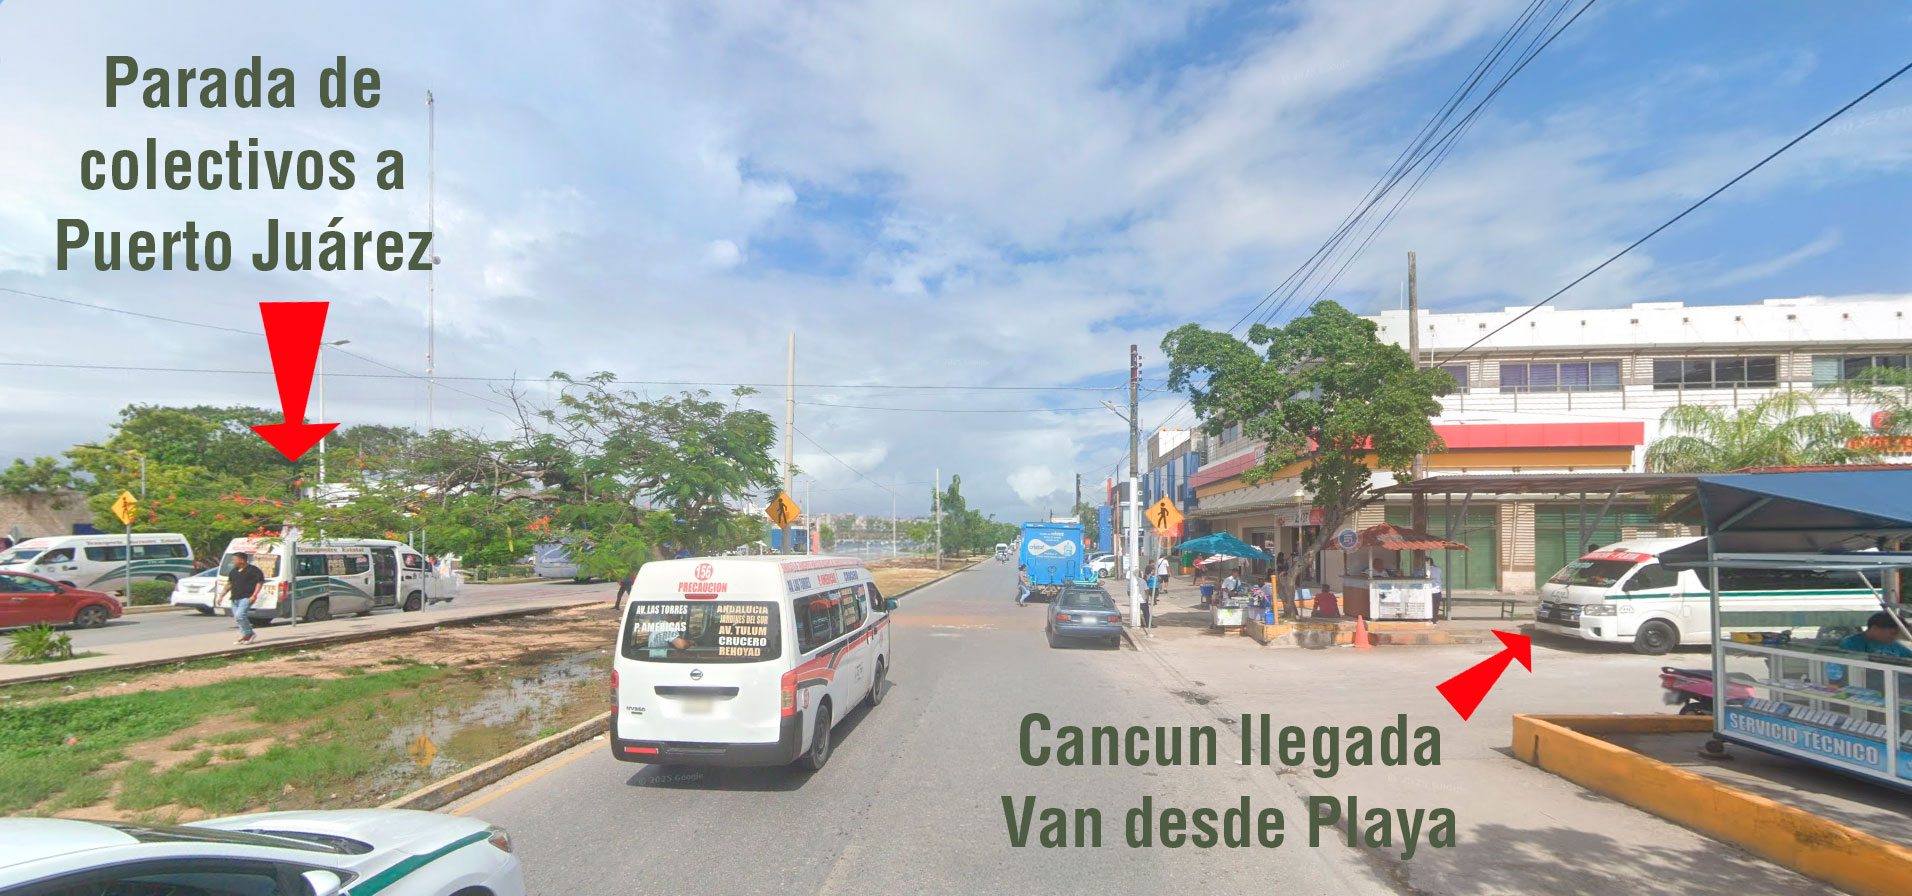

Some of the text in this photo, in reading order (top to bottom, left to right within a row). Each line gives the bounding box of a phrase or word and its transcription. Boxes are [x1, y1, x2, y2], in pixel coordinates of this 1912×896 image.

[695, 565, 712, 579] 156
[678, 582, 728, 593] PRECAUCION
[660, 604, 688, 615] TORRES
[716, 604, 769, 615] ANDALUCIA
[719, 614, 769, 625] JARDINES DEL SUR
[718, 625, 768, 636] AV. TULUM
[718, 636, 767, 647] CRUCERO
[1729, 712, 1799, 745] SERVICIO
